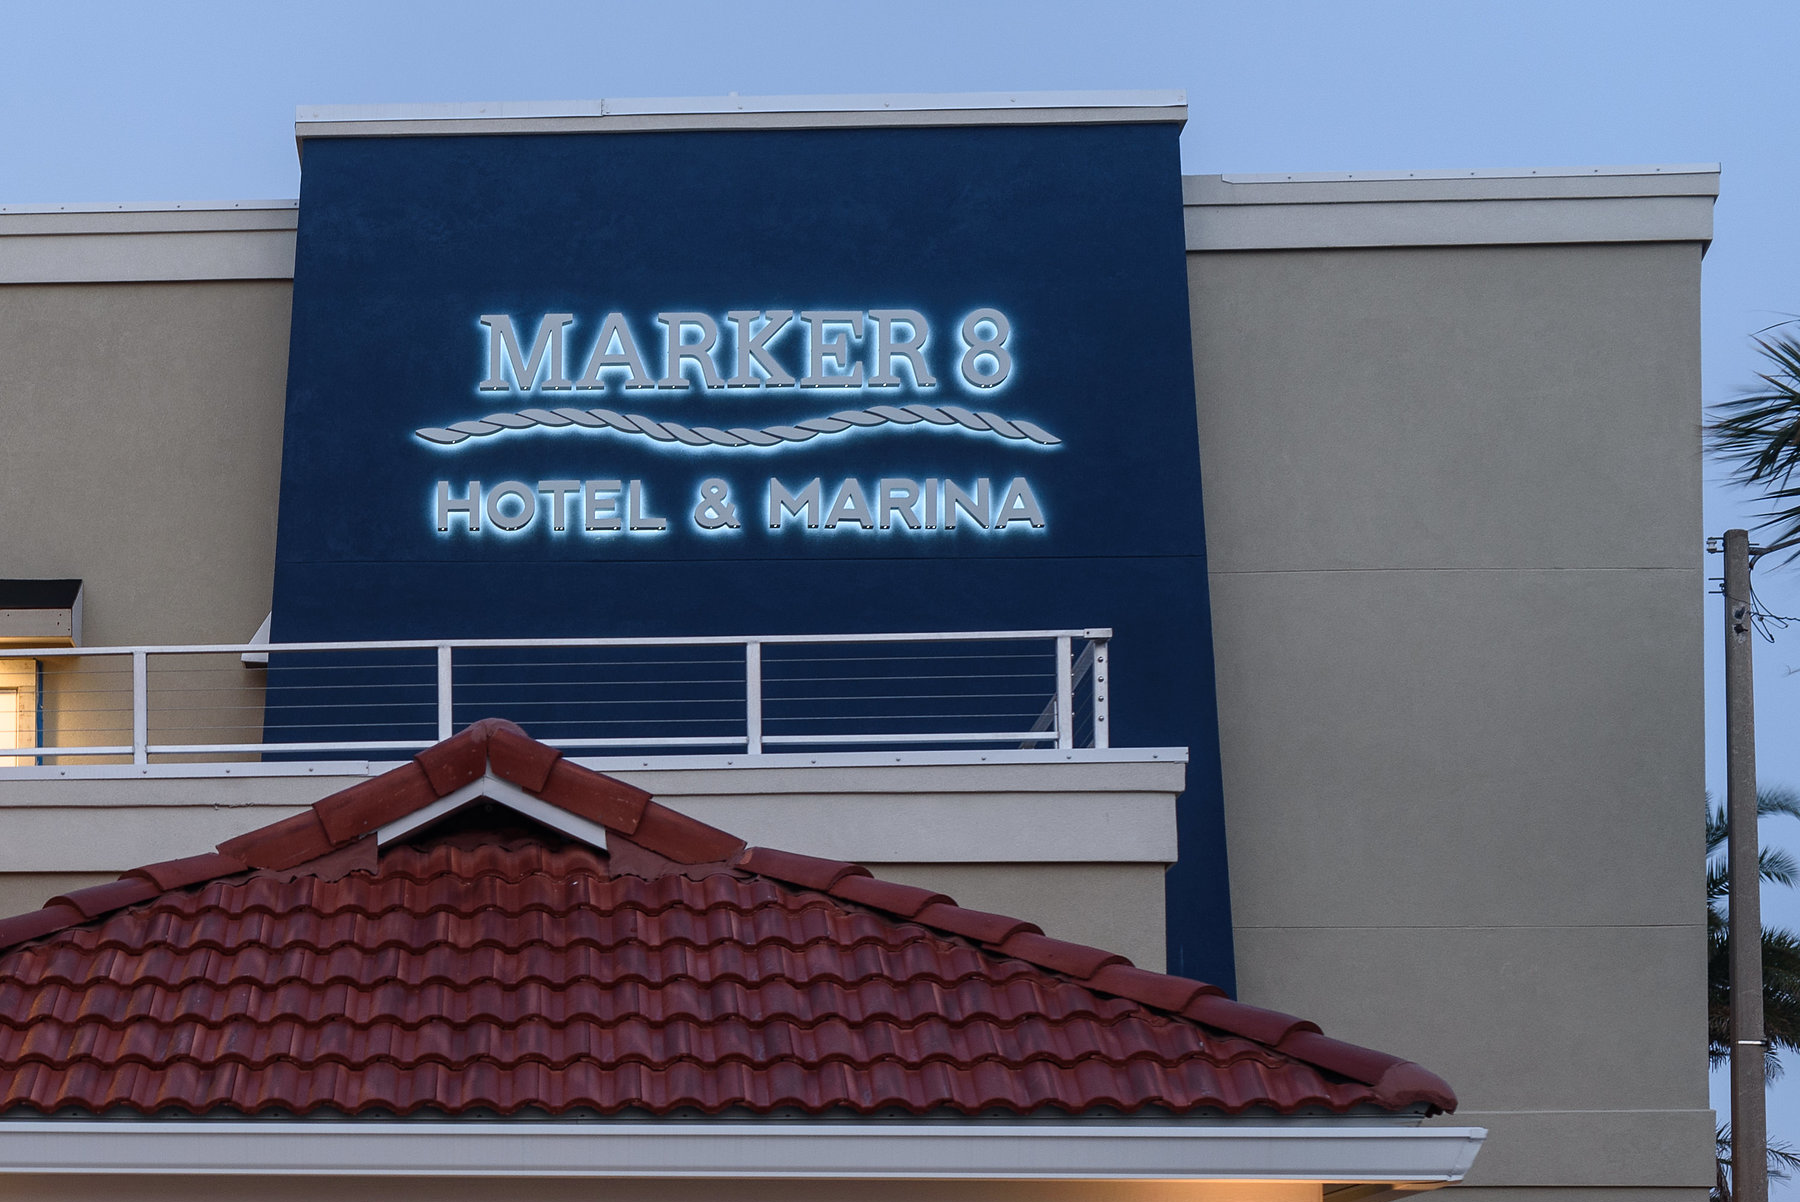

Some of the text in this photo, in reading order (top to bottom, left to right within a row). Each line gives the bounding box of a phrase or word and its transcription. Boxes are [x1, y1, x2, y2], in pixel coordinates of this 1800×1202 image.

[479, 307, 1012, 391] MARKER 8
[437, 476, 1045, 532] HOTEL & MARINA
